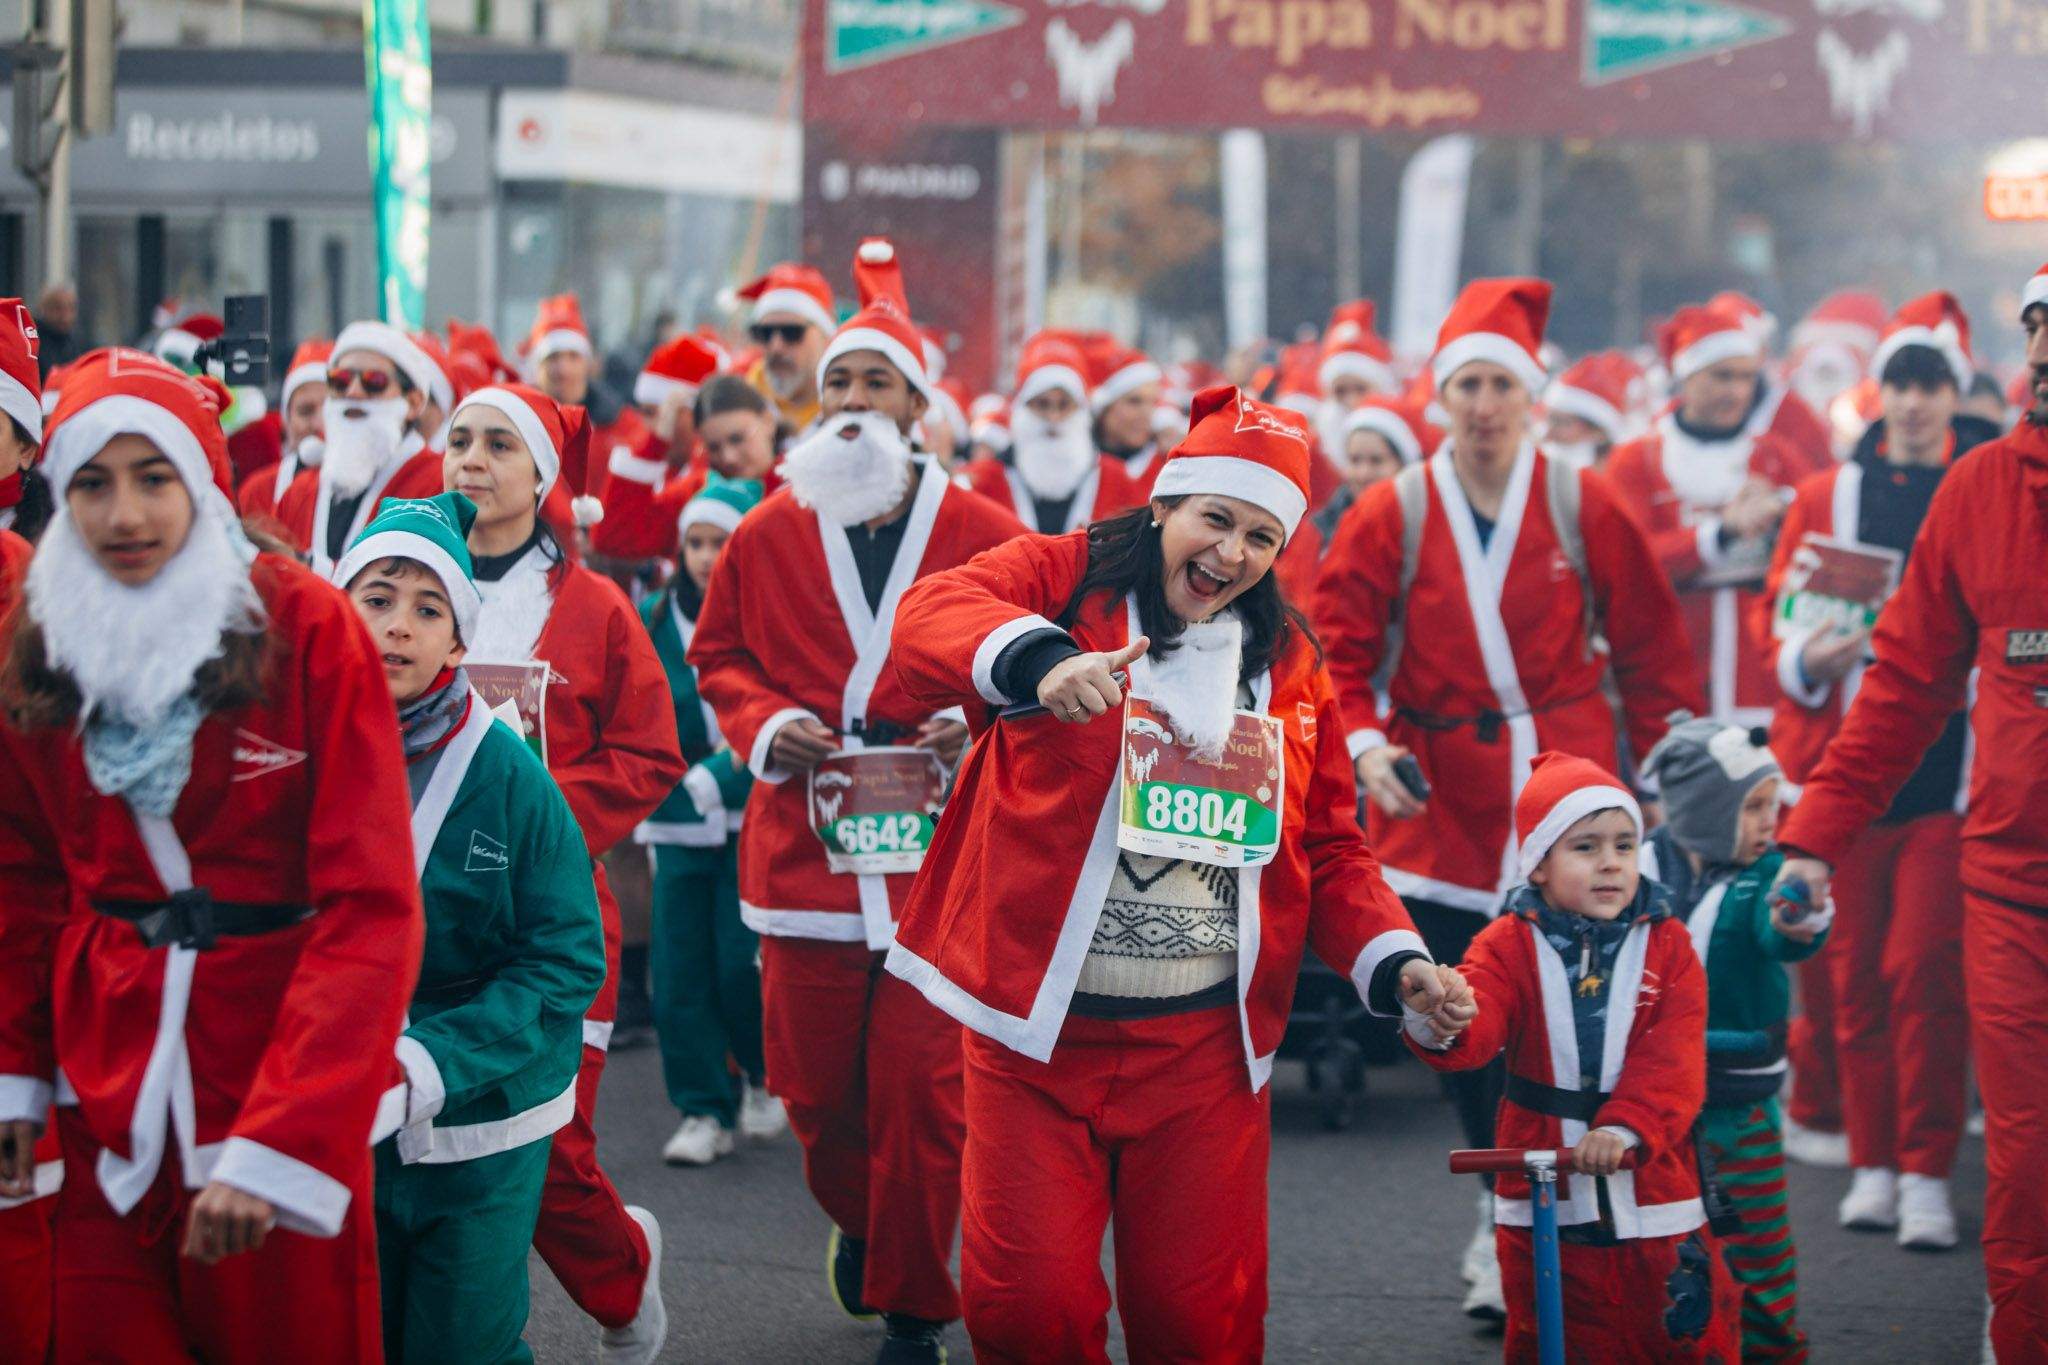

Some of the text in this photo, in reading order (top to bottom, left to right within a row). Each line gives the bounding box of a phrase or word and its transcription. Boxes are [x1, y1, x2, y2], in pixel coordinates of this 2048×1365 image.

[126, 110, 321, 161] Recoletos
[1226, 738, 1264, 759] Noel
[836, 814, 922, 855] 6642
[1146, 785, 1248, 842] 8804
